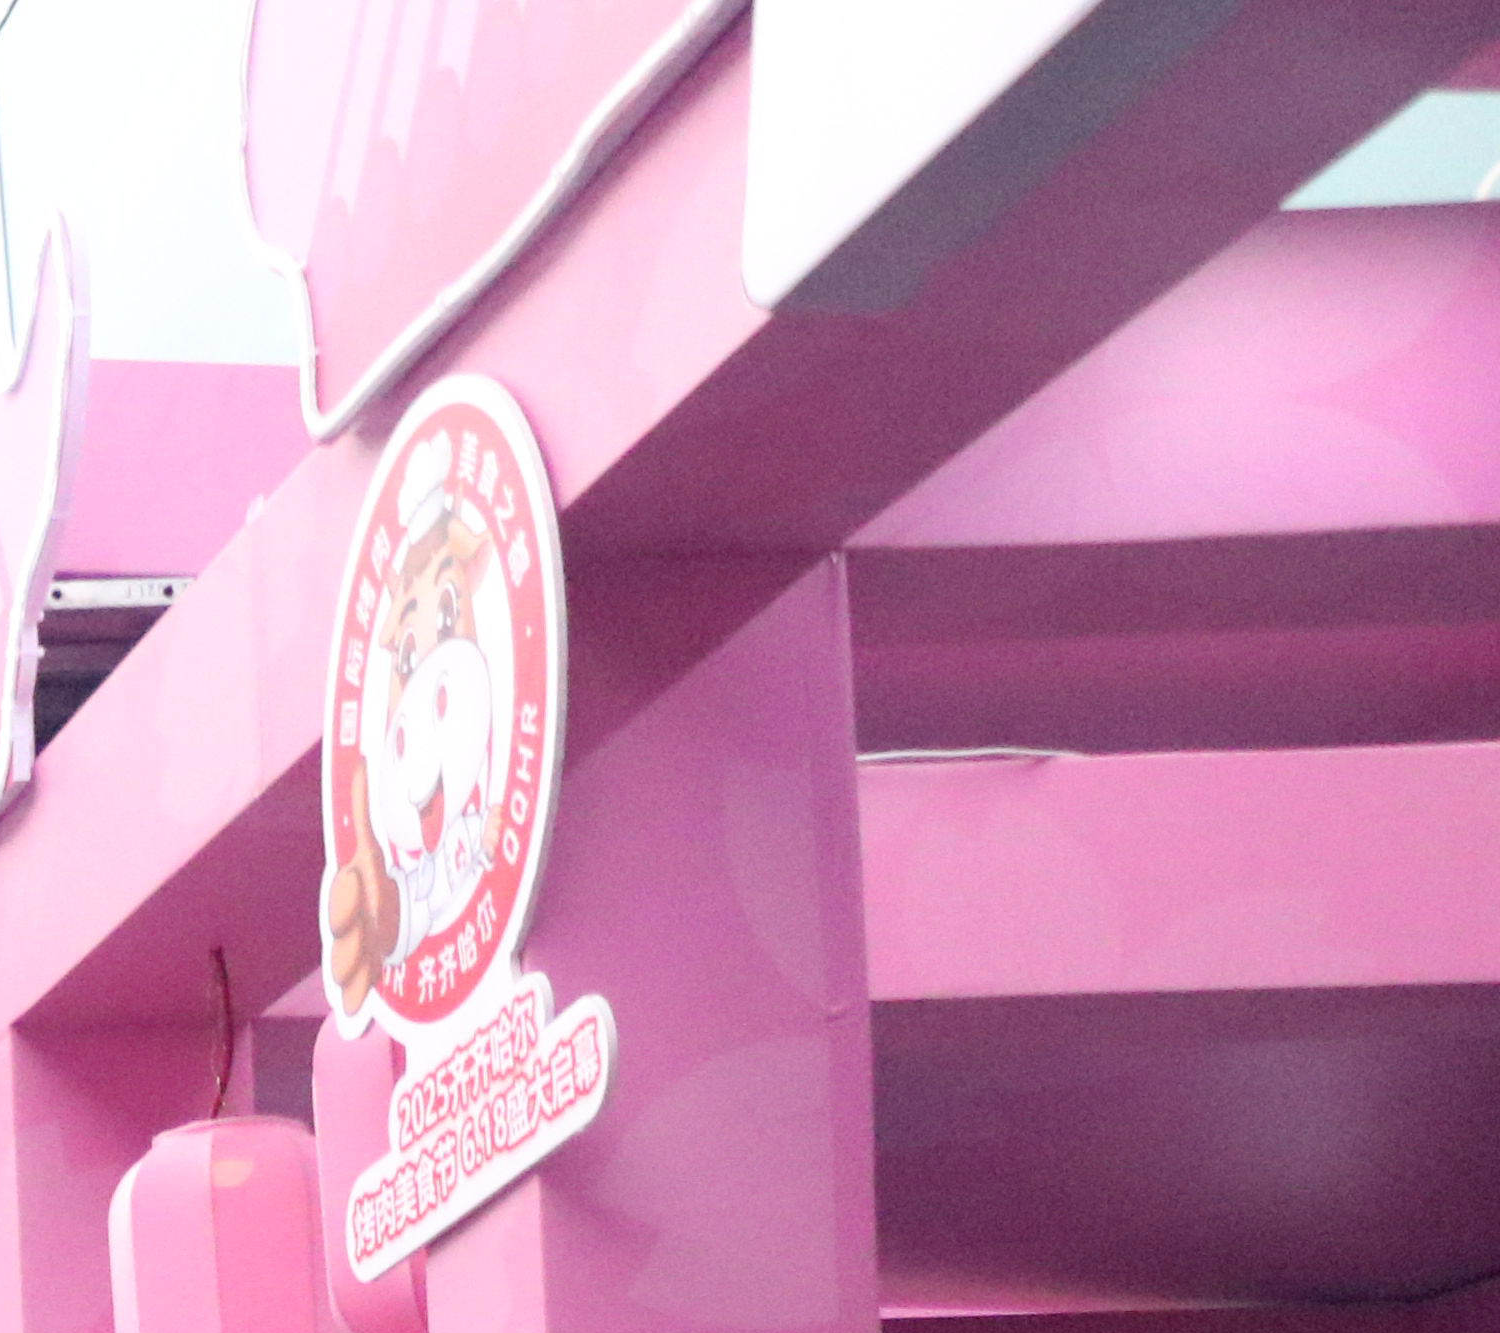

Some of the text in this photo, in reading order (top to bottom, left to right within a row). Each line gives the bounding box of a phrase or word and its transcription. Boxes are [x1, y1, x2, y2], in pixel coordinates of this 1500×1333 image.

[417, 888, 497, 1004] 齐齐哈尔
[398, 990, 538, 1151] 2025齐齐哈尔
